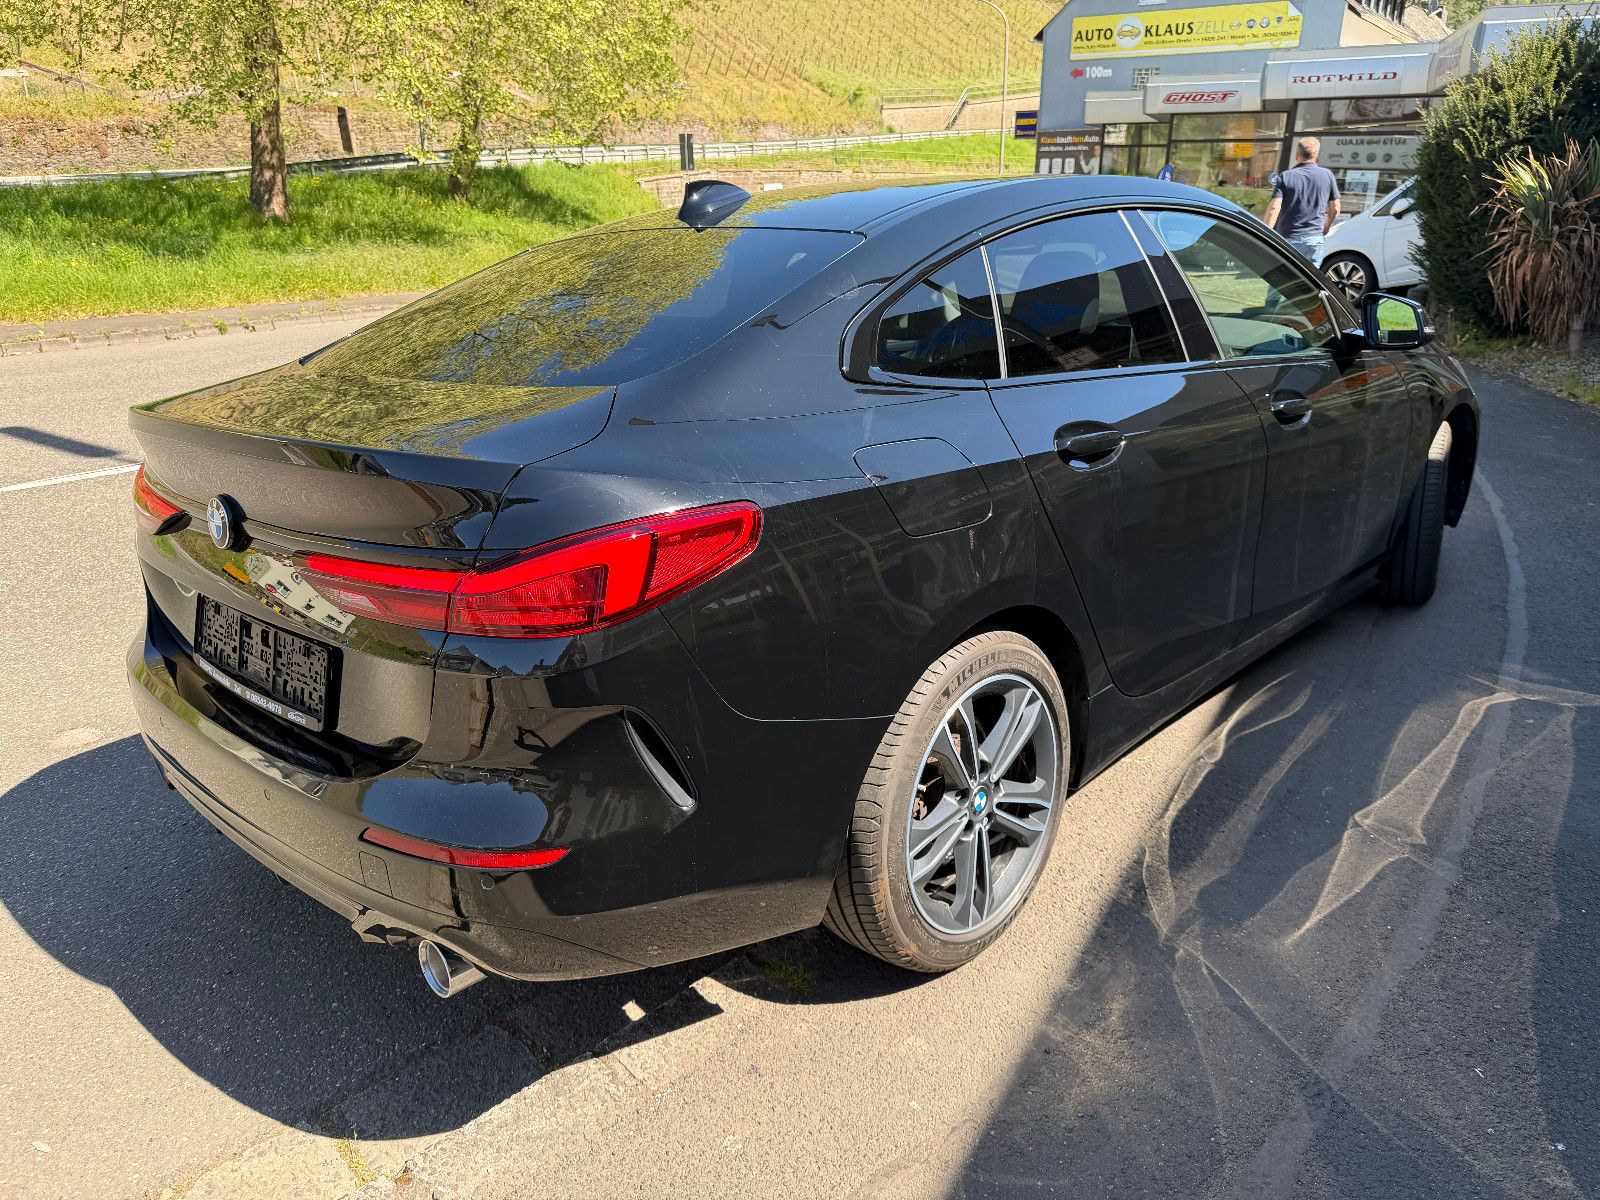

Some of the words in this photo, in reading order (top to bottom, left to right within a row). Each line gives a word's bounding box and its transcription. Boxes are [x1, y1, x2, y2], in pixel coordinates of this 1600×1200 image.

[1074, 28, 1114, 42] AUTO
[1144, 22, 1194, 38] KLAUS
[1085, 66, 1113, 79] 100m
[1162, 90, 1239, 105] GHOST
